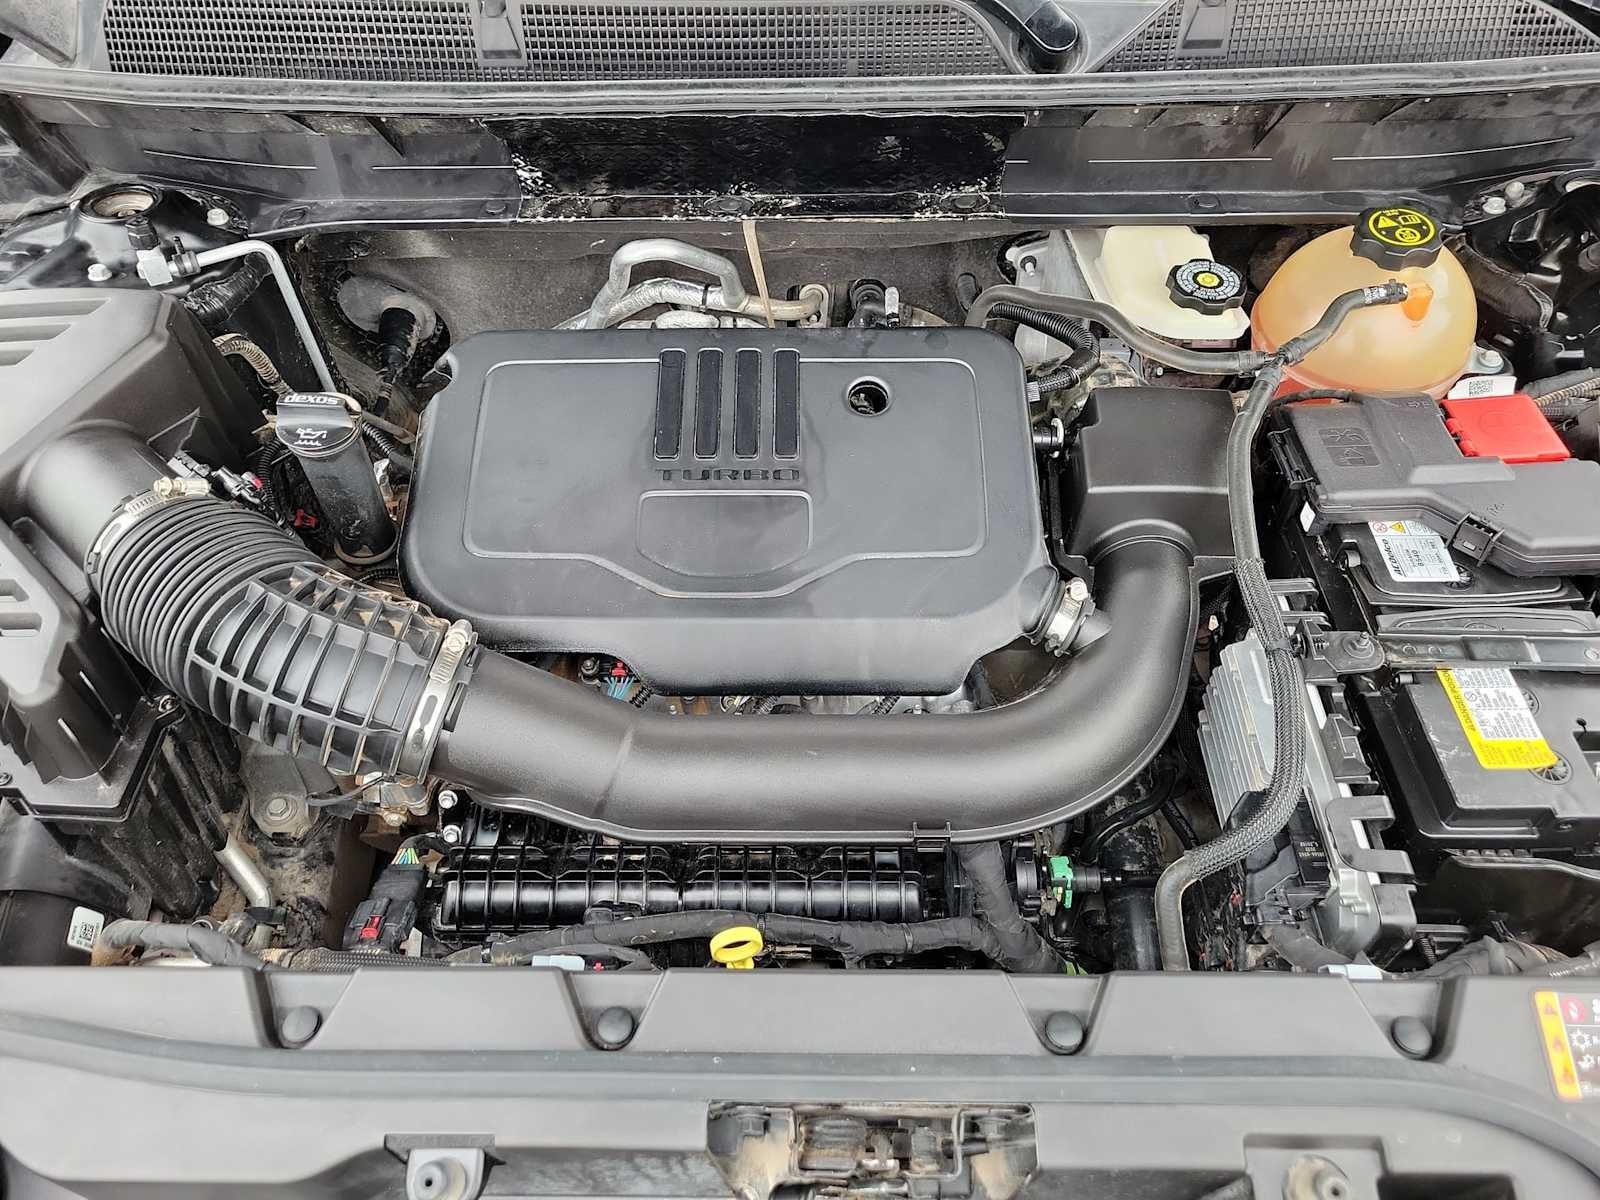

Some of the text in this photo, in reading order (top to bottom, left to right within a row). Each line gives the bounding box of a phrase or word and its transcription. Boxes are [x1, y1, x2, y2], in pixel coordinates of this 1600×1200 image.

[284, 393, 338, 405] dexos
[655, 469, 800, 481] TURBO
[1382, 538, 1402, 577] ACDelco
